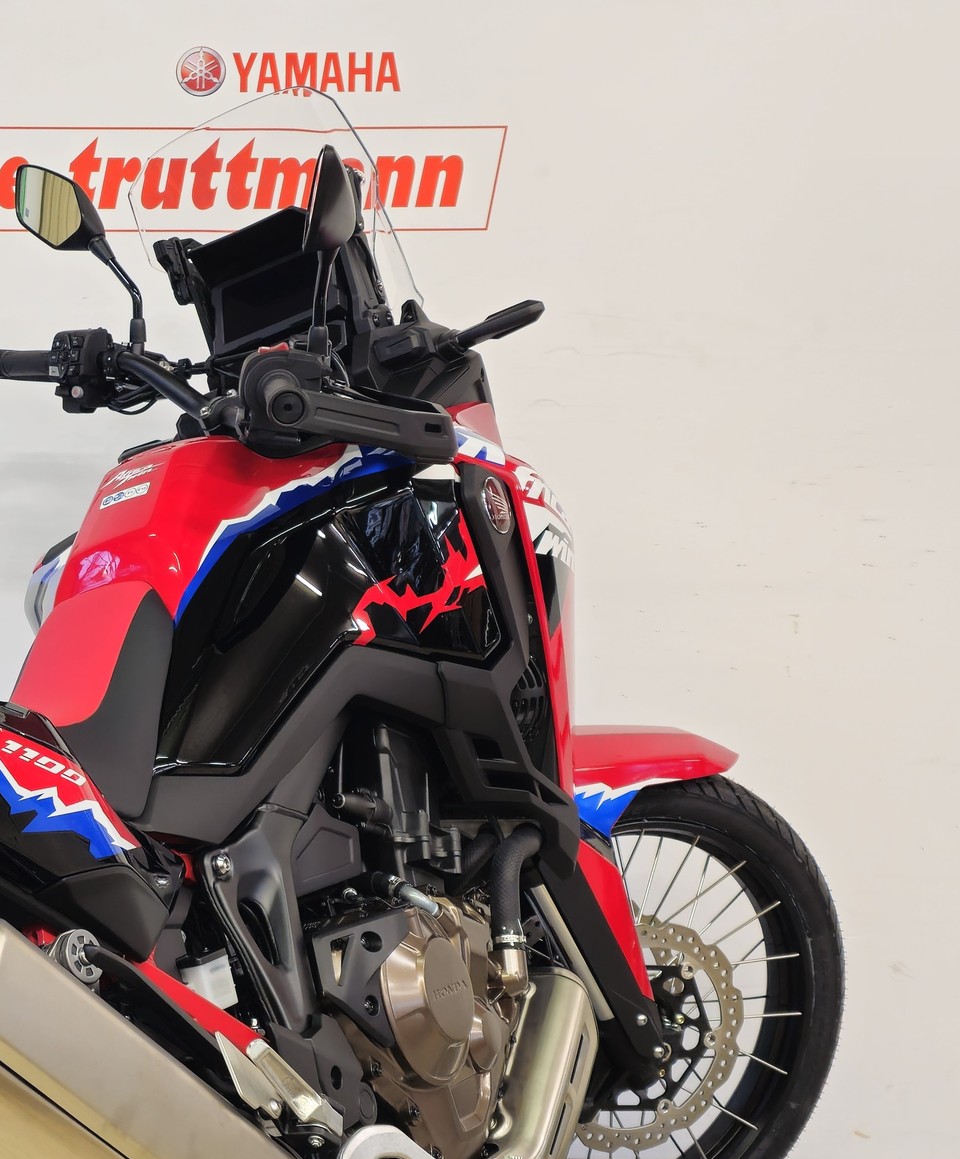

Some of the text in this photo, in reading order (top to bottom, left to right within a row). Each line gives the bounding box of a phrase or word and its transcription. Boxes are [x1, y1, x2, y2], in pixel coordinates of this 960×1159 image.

[232, 51, 401, 96] YAMAHA
[68, 135, 464, 211] truttmnn
[0, 739, 87, 787] 1100
[431, 979, 469, 1001] HONDA
